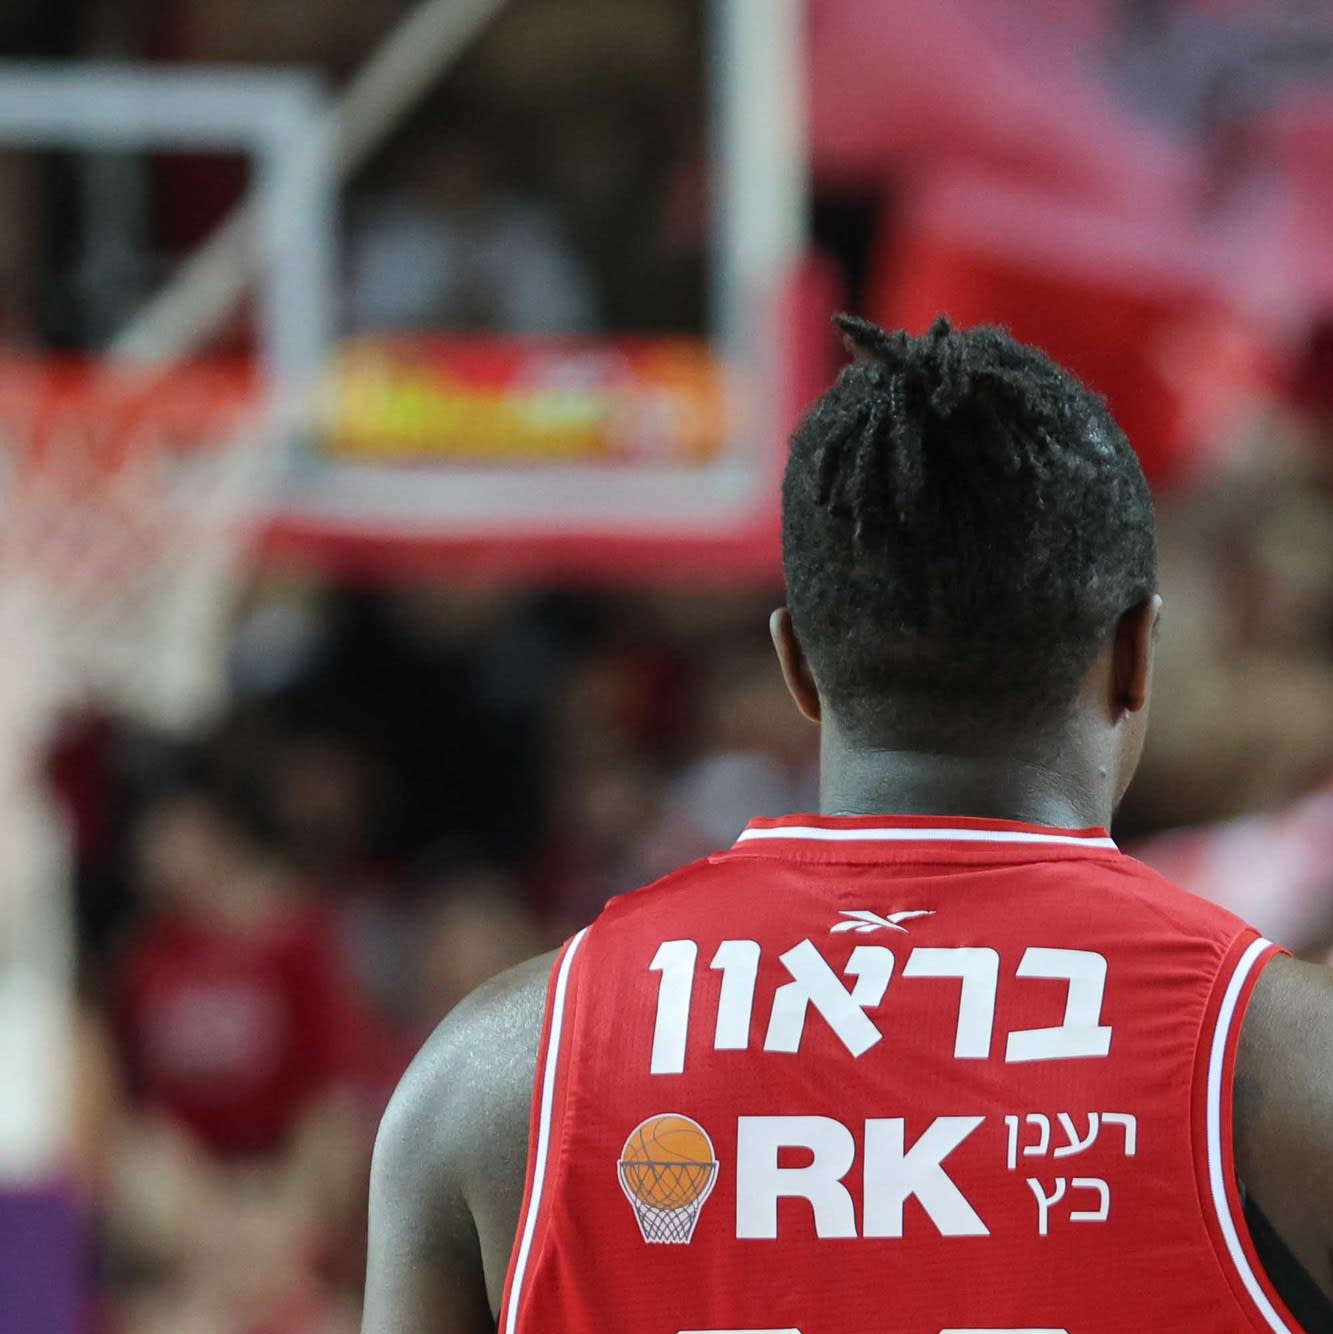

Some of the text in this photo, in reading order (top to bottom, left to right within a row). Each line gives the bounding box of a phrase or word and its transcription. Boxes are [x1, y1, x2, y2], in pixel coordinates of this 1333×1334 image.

[649, 939, 1112, 1075] בראון
[736, 1115, 991, 1239] RK
[1005, 1112, 1137, 1170] רענן
[1026, 1178, 1110, 1236] כץ
